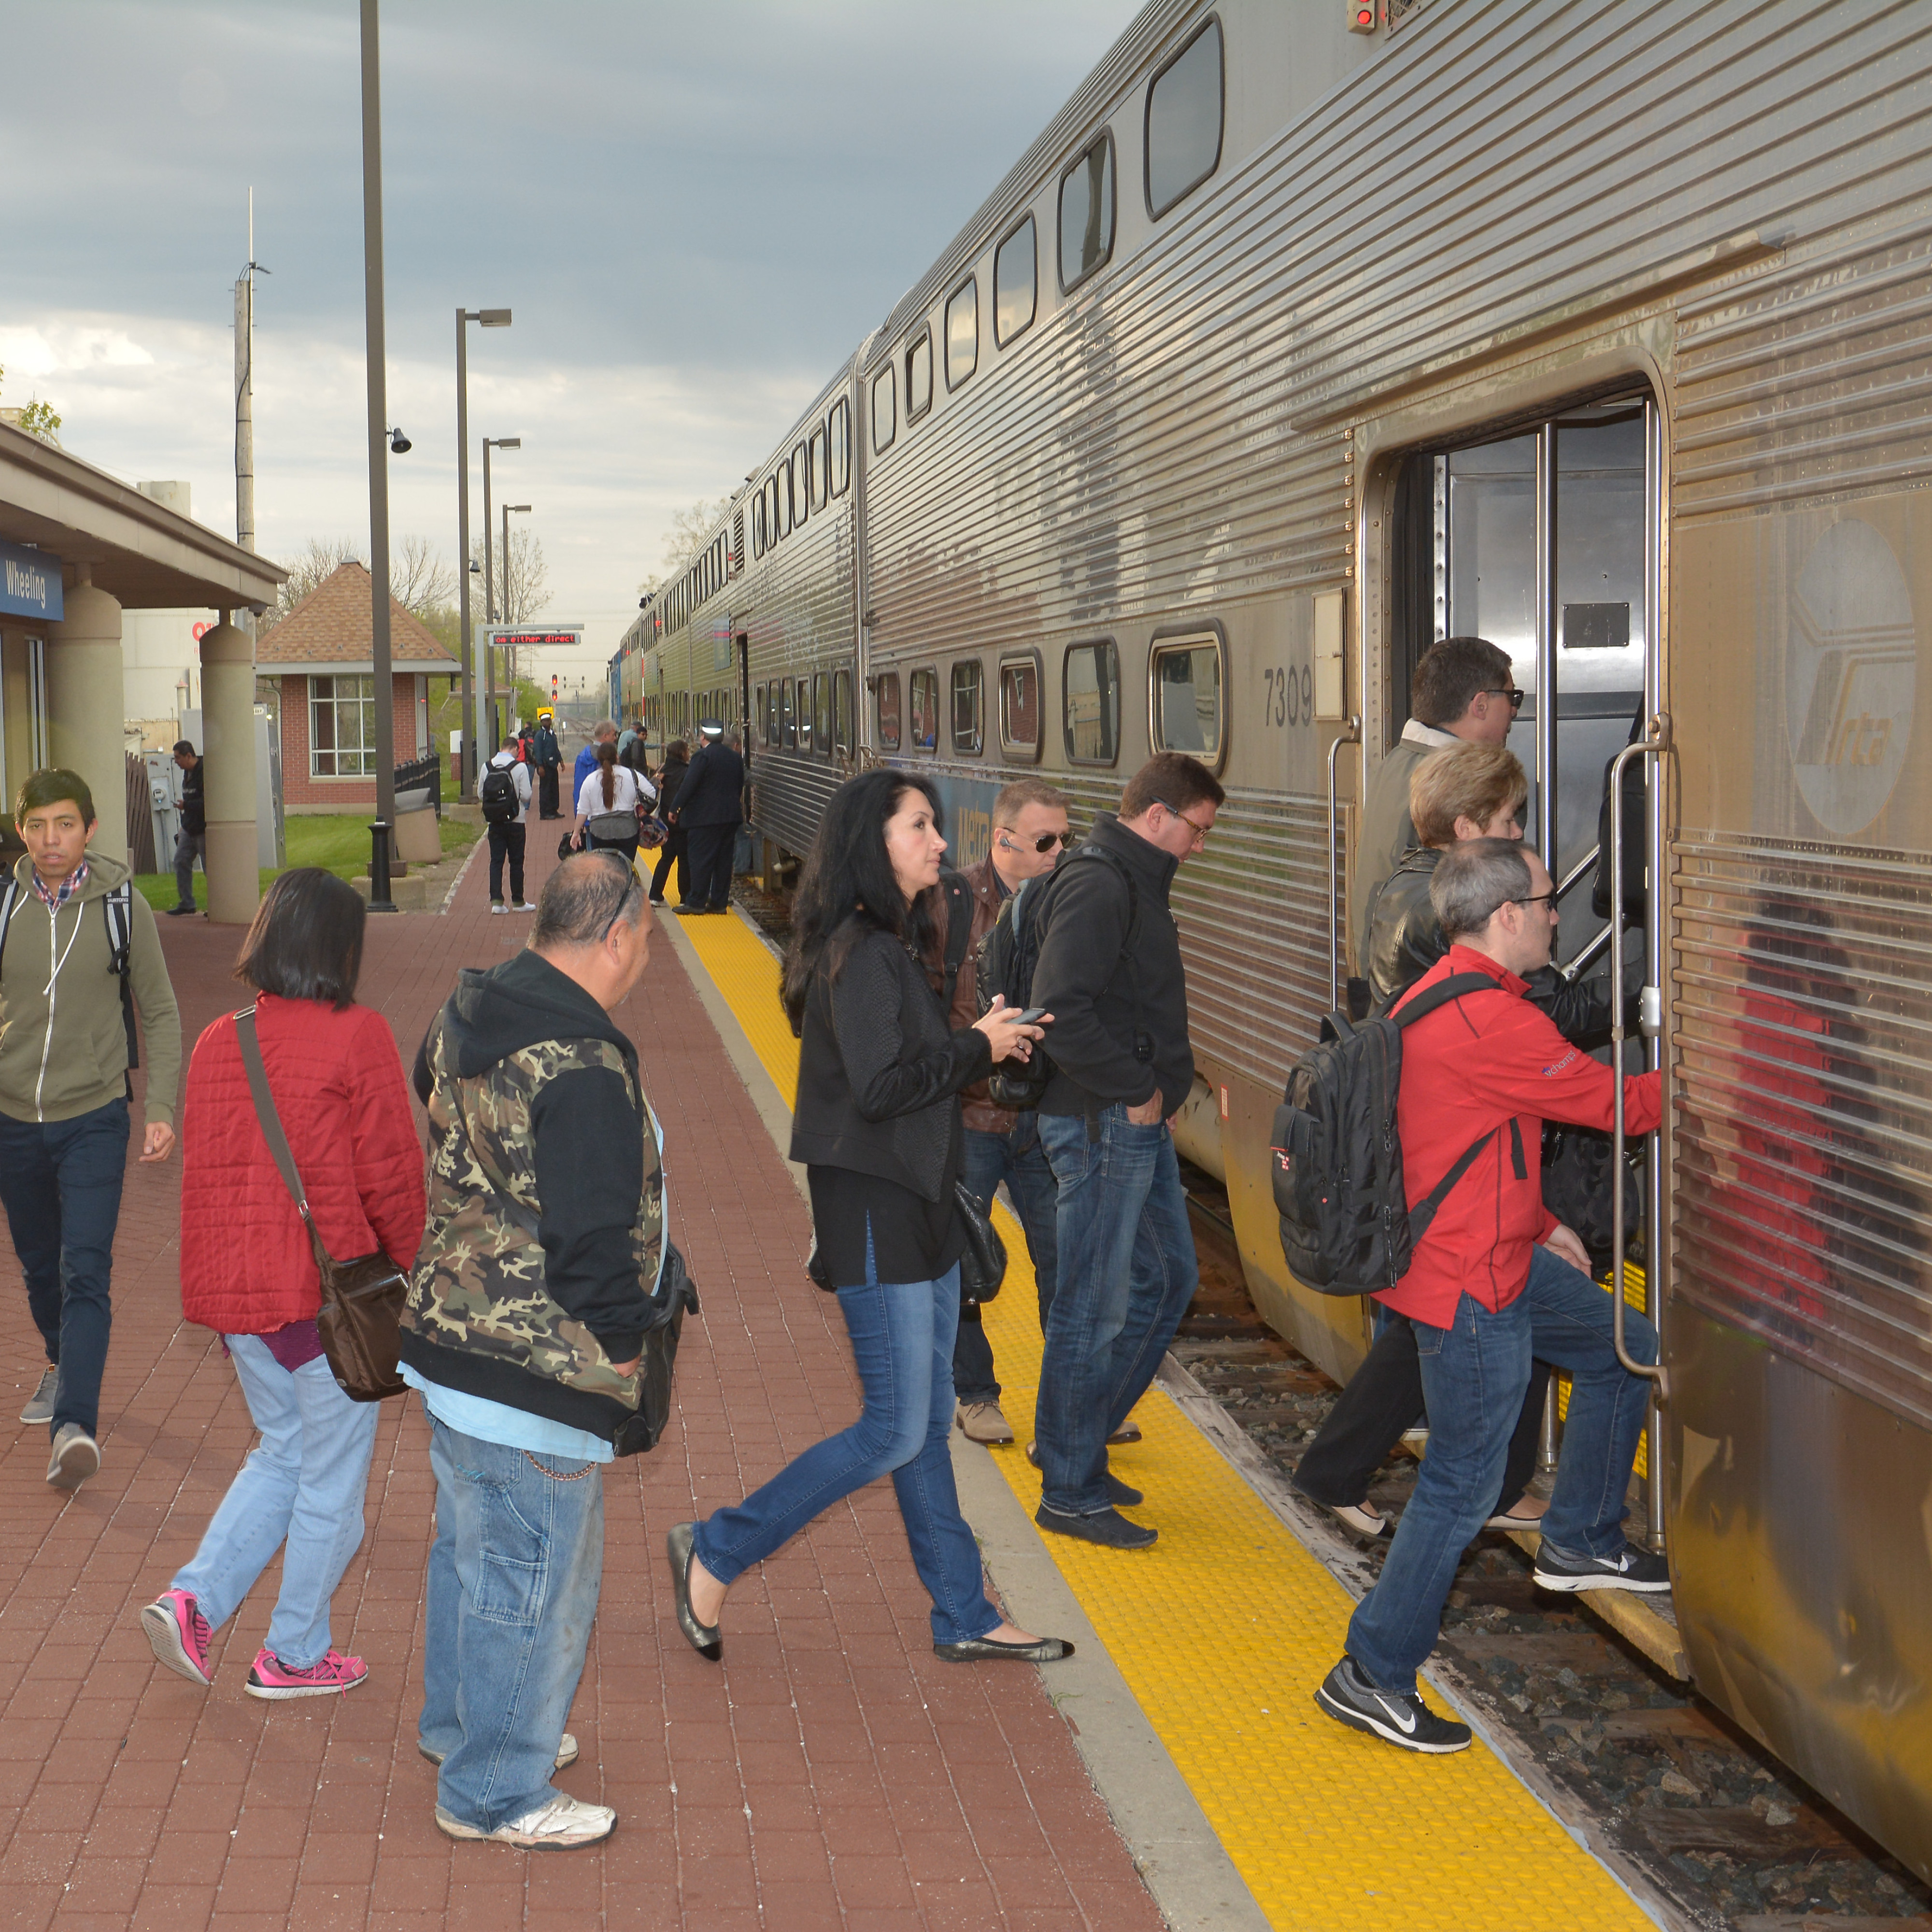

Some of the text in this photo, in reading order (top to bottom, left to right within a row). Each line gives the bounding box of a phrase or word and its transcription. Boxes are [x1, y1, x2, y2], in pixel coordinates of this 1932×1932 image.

[6, 560, 46, 609] Wheeling
[510, 635, 541, 643] either
[545, 634, 574, 643] direct
[1264, 664, 1312, 727] 7309
